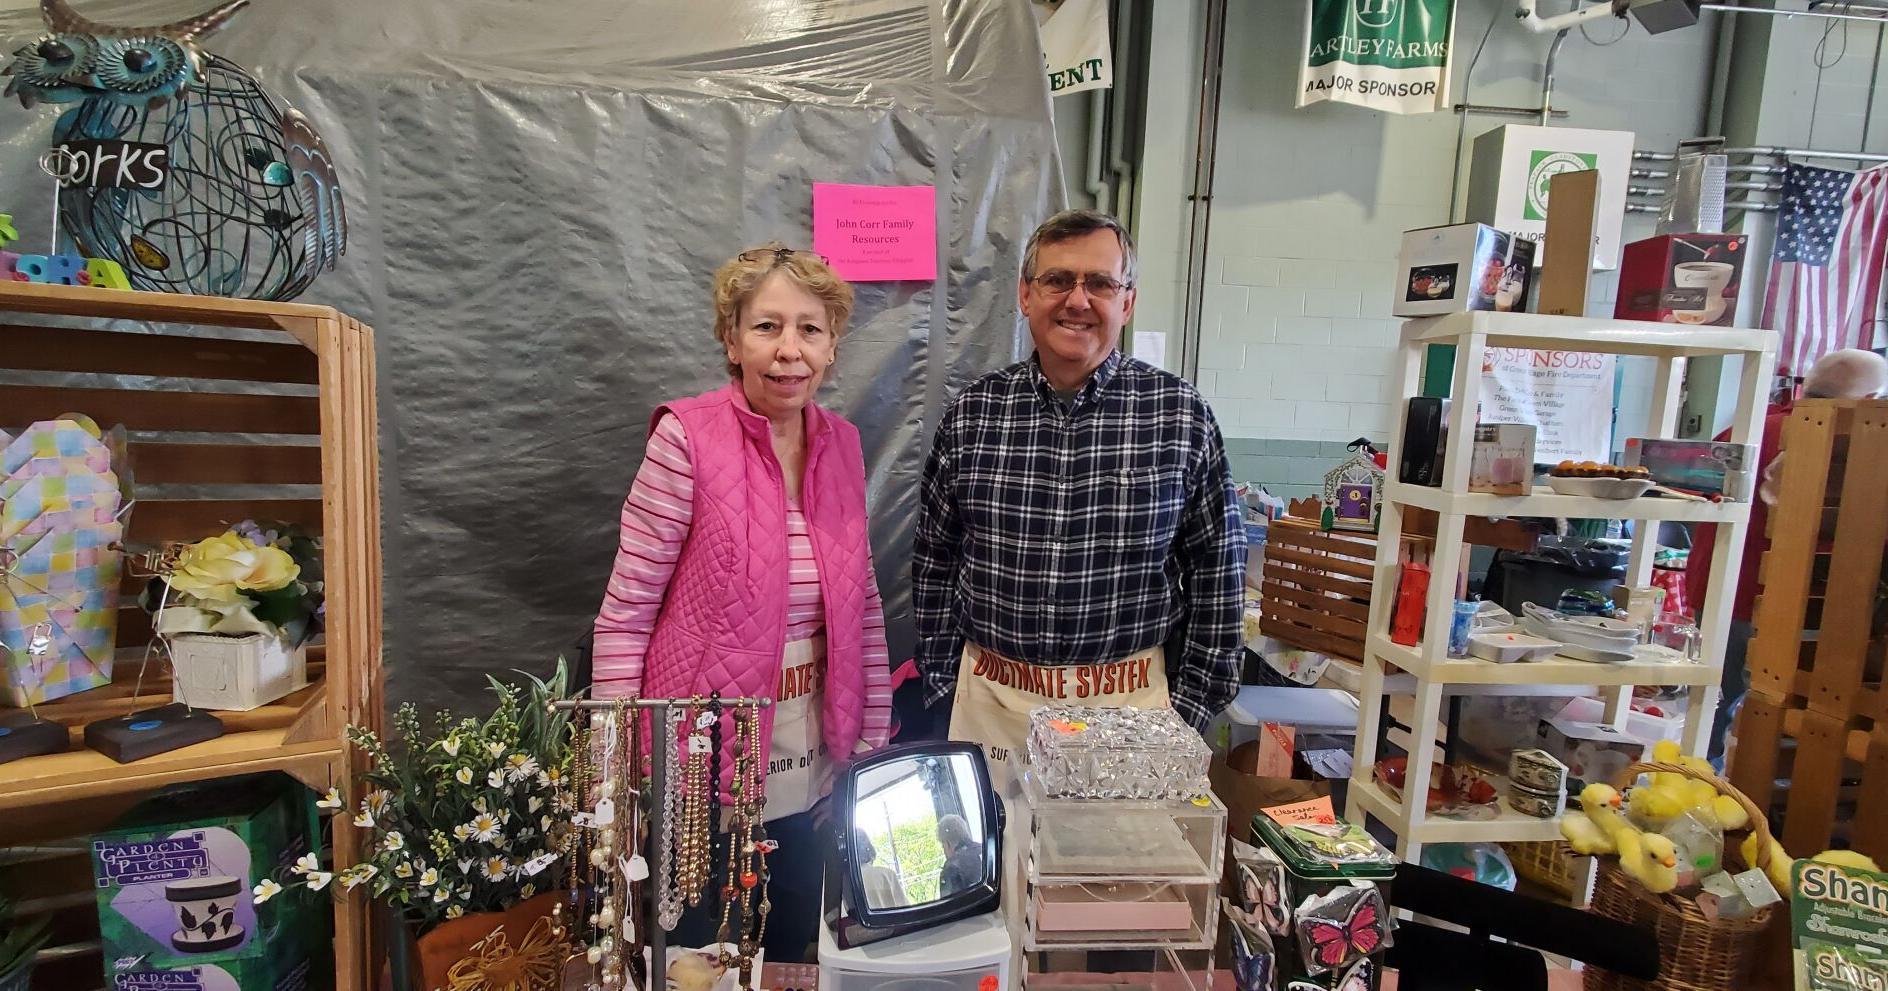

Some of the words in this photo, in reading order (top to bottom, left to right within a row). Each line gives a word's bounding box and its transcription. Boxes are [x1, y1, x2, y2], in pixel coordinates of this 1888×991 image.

[1311, 36, 1384, 58] ARTLEY
[1386, 39, 1449, 59] FARMS
[1048, 58, 1103, 91] ENT
[1305, 75, 1353, 93] MAJOR
[1358, 79, 1436, 97] SPONSOR
[836, 218, 857, 229] John
[860, 219, 880, 229] Corr
[883, 219, 914, 230] Family
[852, 234, 900, 244] Resources
[132, 872, 165, 882] PLANTER
